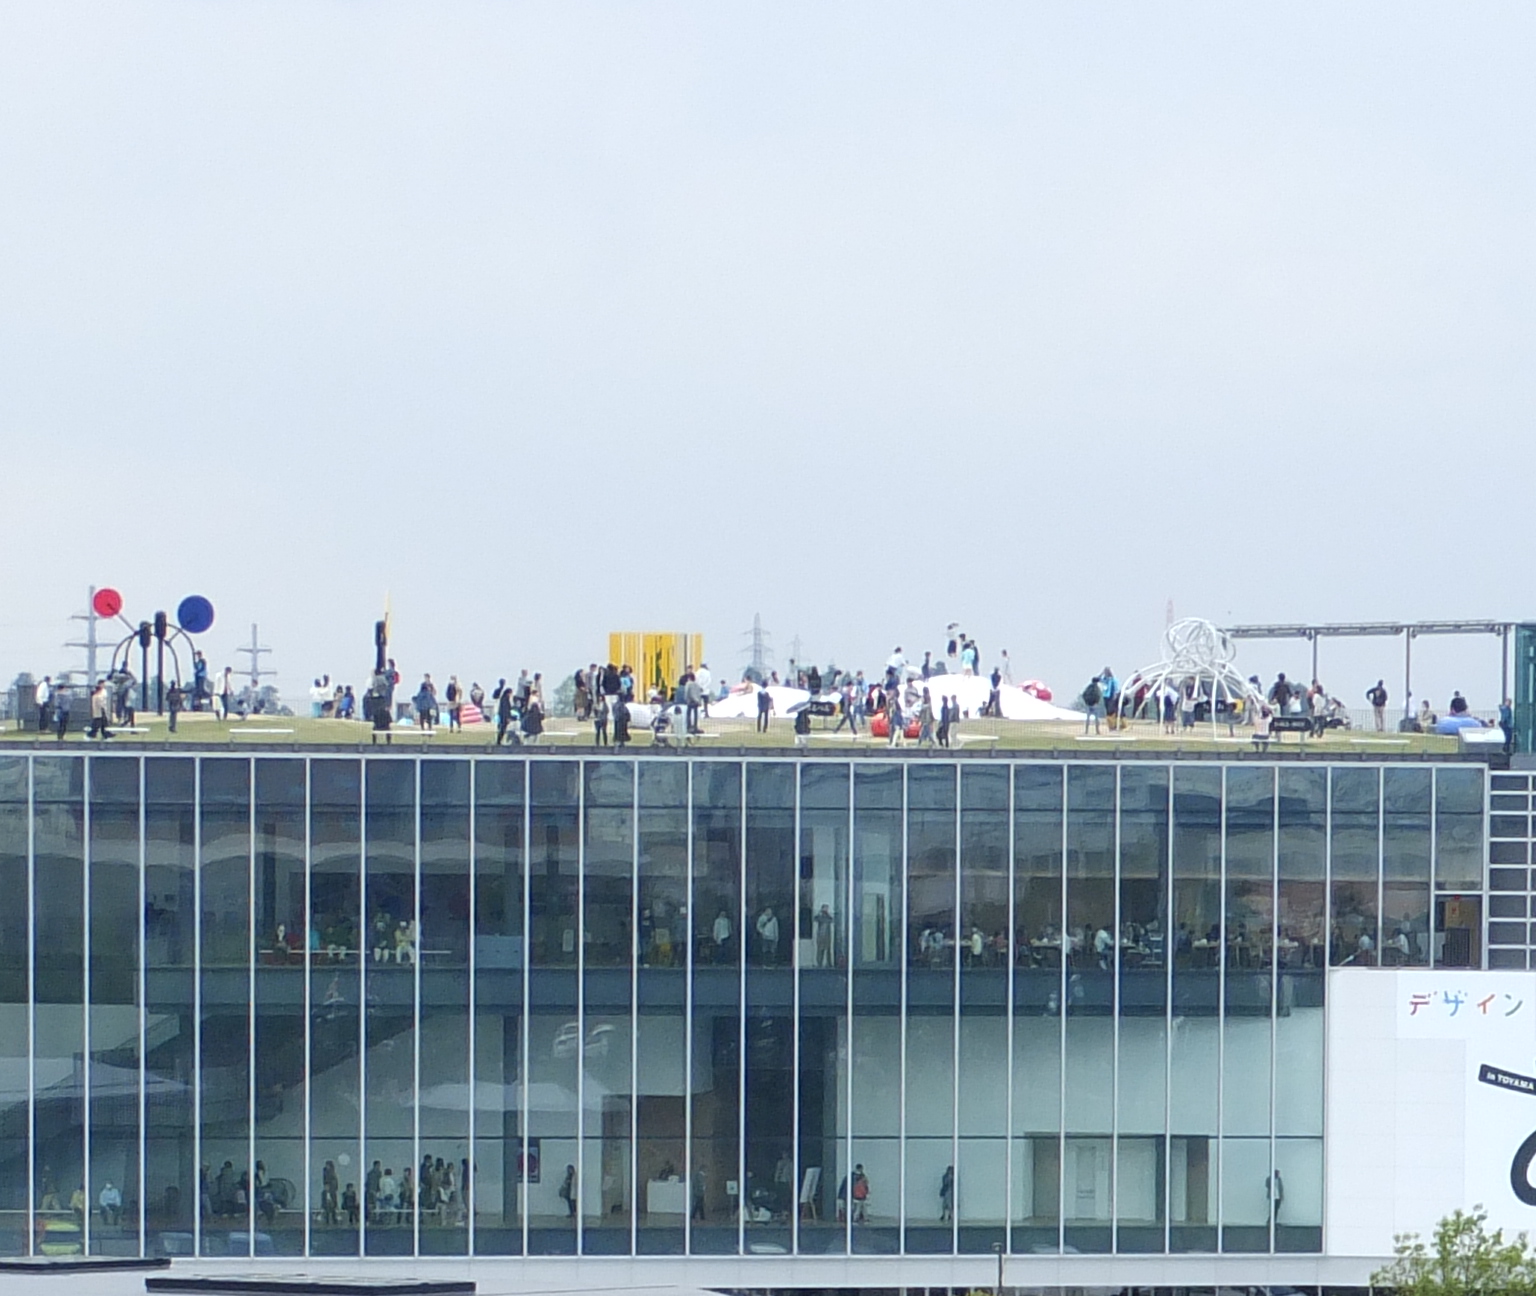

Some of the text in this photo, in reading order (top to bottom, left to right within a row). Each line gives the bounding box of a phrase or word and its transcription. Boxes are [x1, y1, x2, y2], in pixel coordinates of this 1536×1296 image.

[1409, 989, 1523, 1017] デザイン
[1497, 1074, 1535, 1091] TOYAMA
